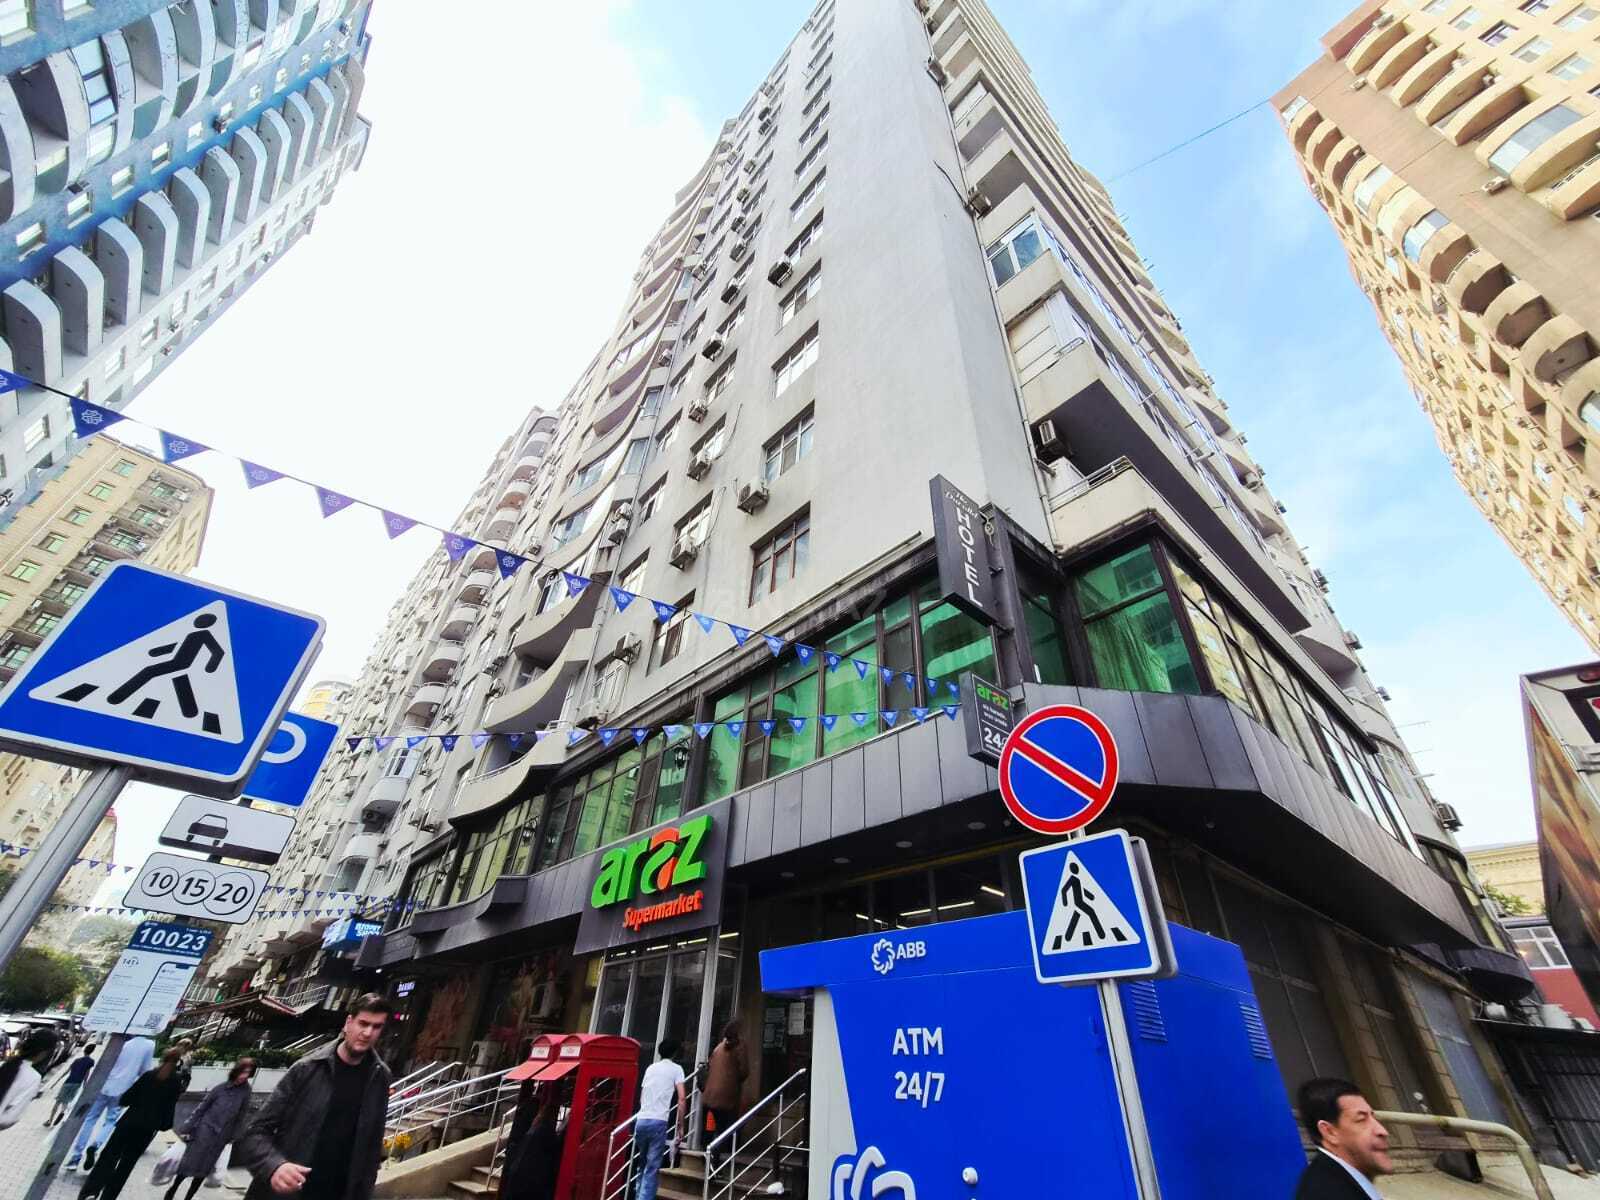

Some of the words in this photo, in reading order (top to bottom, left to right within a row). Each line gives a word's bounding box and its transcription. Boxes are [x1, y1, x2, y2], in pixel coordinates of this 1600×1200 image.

[956, 507, 984, 608] HOTEL
[977, 683, 1009, 711] araz
[591, 815, 713, 909] araz
[148, 871, 174, 890] 10
[181, 876, 209, 897] 15
[213, 882, 248, 905] 20
[623, 889, 704, 933] Supermarket
[140, 927, 207, 951] 10023
[896, 941, 926, 960] ABB
[892, 1027, 944, 1056] ATM
[894, 1070, 945, 1109] 24/7
